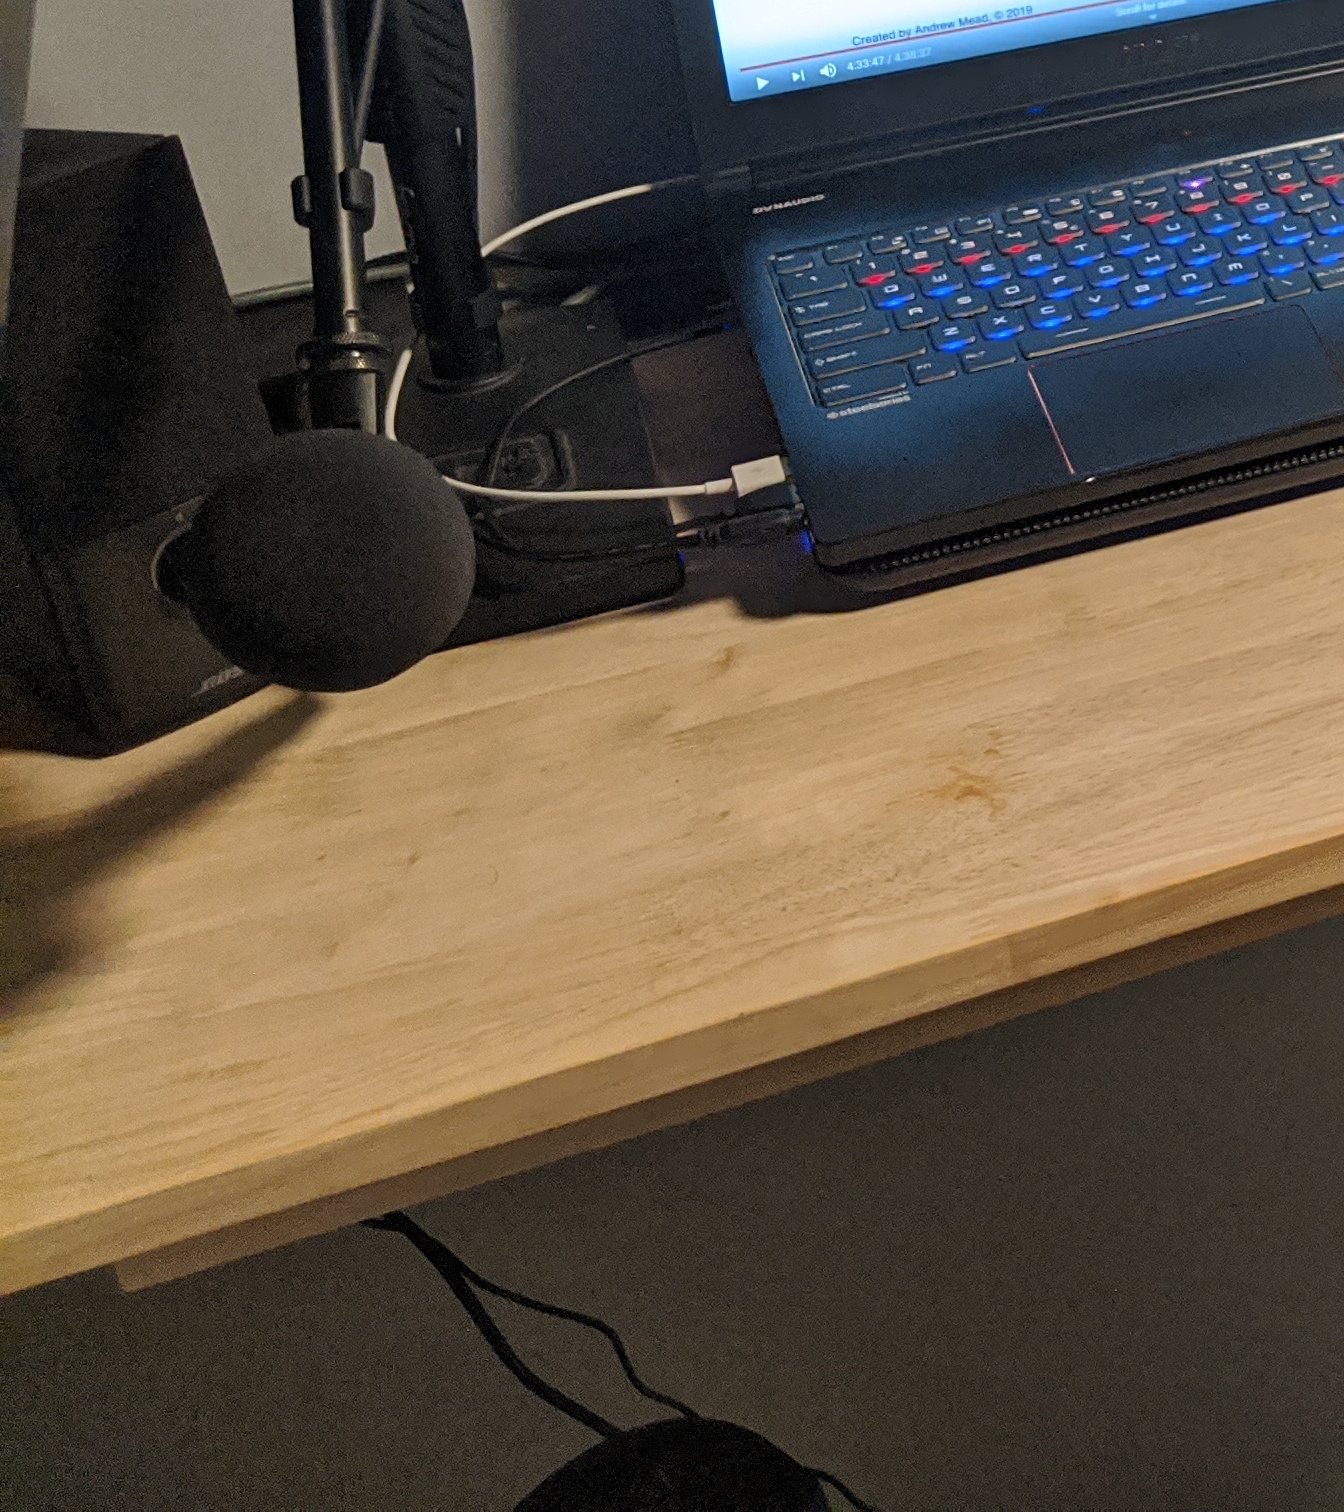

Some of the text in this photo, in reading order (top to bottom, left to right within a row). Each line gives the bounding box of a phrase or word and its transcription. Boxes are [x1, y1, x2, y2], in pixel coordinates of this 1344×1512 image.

[851, 29, 897, 48] Created
[898, 25, 912, 40] by
[914, 18, 956, 36] Andrew
[958, 13, 991, 30] Mead,
[1005, 3, 1034, 20] 2019
[846, 54, 885, 73] 4:33:47
[752, 194, 826, 215] DYNAUDIO
